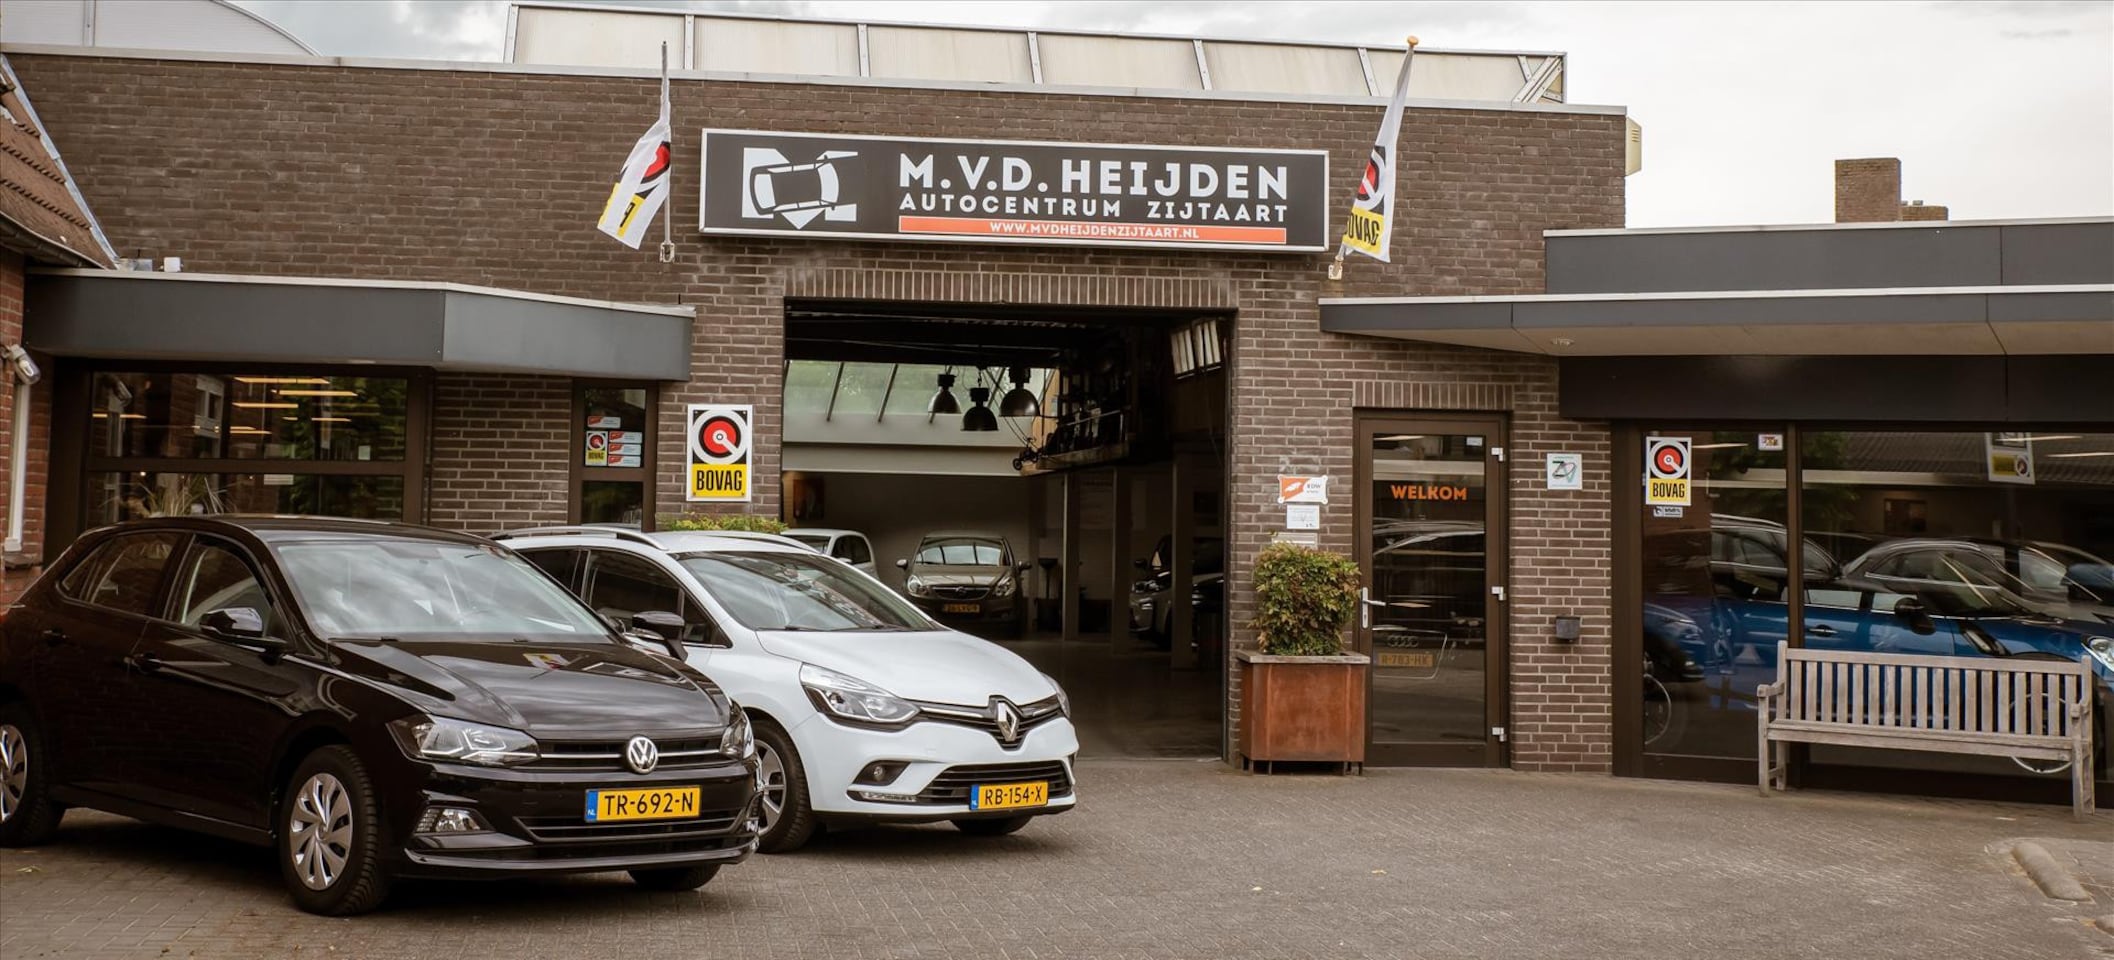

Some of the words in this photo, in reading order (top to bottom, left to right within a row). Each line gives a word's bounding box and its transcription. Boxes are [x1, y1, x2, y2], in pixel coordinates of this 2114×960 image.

[900, 153, 1048, 192] M.V.D.
[1062, 159, 1287, 200] HEIJDEN
[899, 193, 1120, 217] AUTOCENTRUM
[1147, 201, 1287, 222] ZIJTAART
[990, 221, 1199, 239] WWW.MVDHEIJDENZIJTAART.NL
[1344, 213, 1380, 246] OVAG
[696, 470, 742, 491] BOVAG
[1652, 482, 1685, 498] BOVAG
[1391, 484, 1467, 500] WELKOM
[604, 791, 693, 816] TR-692-N
[985, 785, 1042, 805] RB-154-X
